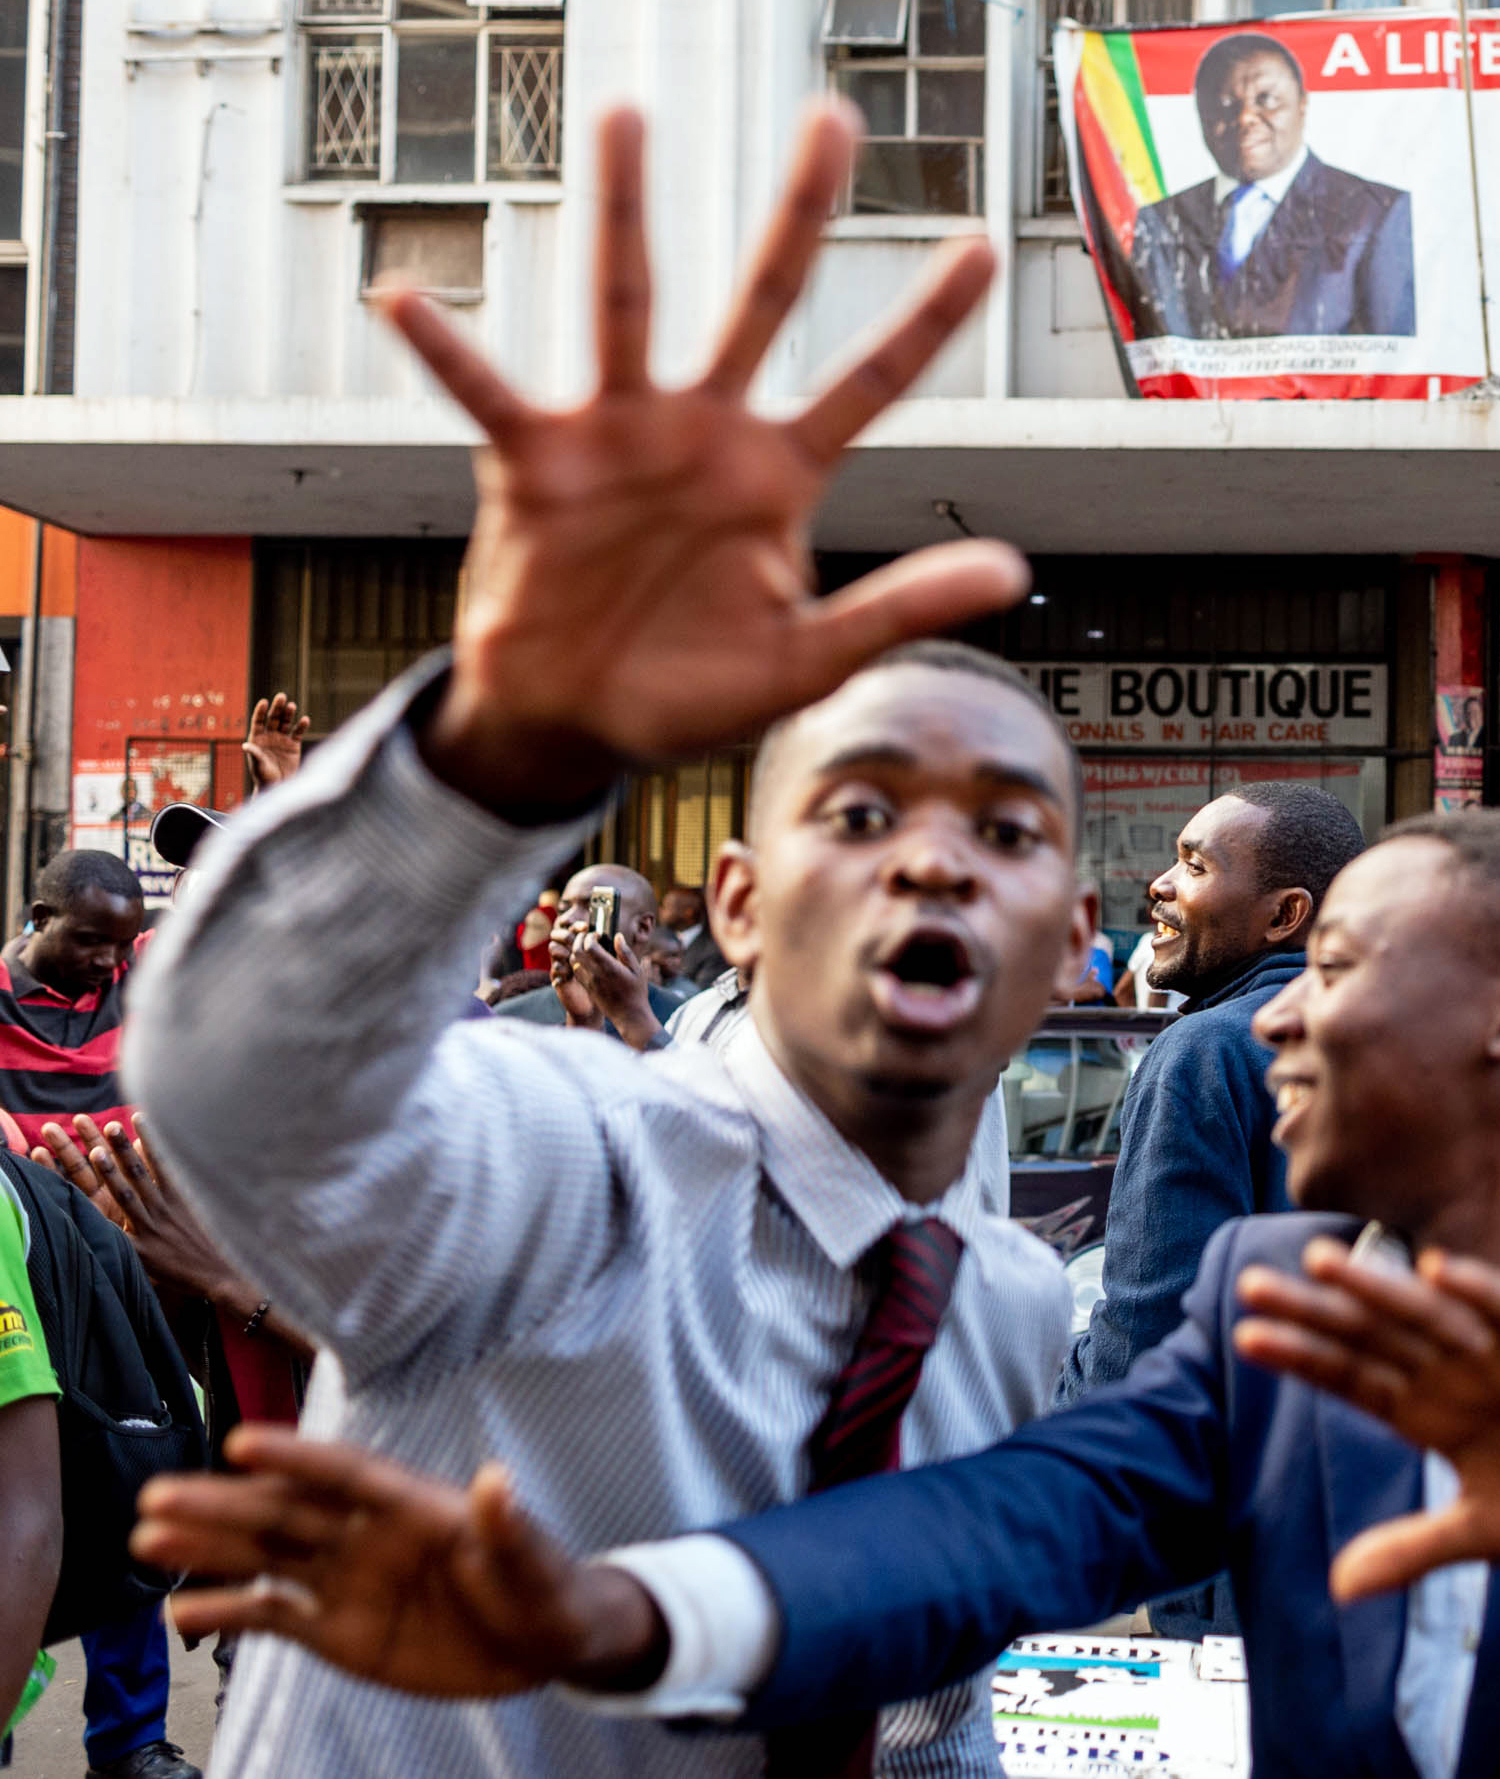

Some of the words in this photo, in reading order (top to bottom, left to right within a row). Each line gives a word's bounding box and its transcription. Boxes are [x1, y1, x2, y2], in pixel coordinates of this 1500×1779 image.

[1321, 34, 1370, 76] A
[1110, 667, 1372, 719] BOUTIQUE
[1067, 721, 1145, 741] ONALS
[1162, 722, 1185, 741] IN
[1201, 722, 1257, 742] HAIR
[1267, 721, 1330, 742] CARE
